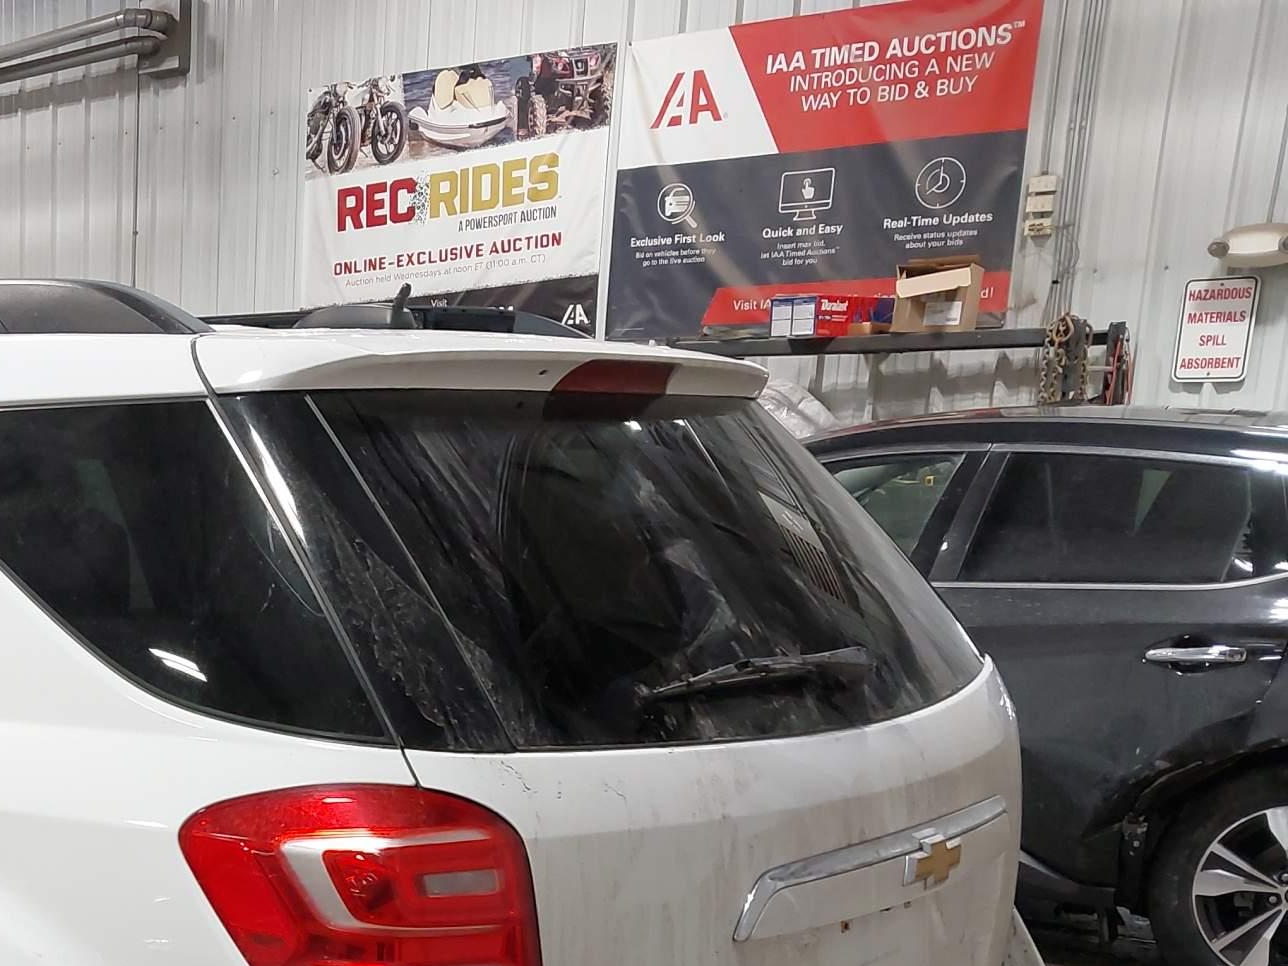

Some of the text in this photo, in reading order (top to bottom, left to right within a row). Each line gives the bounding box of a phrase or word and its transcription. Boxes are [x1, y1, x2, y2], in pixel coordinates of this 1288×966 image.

[766, 52, 806, 74] IAA
[812, 41, 880, 68] TIMED
[790, 51, 995, 91] INTRODUCING A NEW
[801, 75, 978, 111] WAY TO BID & BUY
[337, 152, 560, 233] REC RIDES
[458, 206, 557, 232] A POWERSPORT AUCTION
[883, 212, 993, 229] Real-Time Updates
[762, 223, 843, 239] Quick and Easy
[894, 229, 978, 241] Receive status updates
[631, 231, 725, 247] Exclusive First Look
[905, 238, 963, 249] about your bids
[334, 232, 562, 276] ONLINE-EXCLUSIVE AUCTION
[654, 249, 679, 257] vehicles
[681, 248, 700, 256] before
[771, 250, 785, 258] IAA
[786, 249, 806, 257] Timed
[659, 257, 668, 265] the
[345, 278, 374, 287] Auction
[376, 273, 392, 283] held
[393, 268, 442, 281] Wednesdays
[444, 267, 452, 275] at
[1188, 286, 1253, 301] HAZARDOUS
[431, 298, 448, 308] Visit
[733, 299, 757, 311] Visit
[1187, 310, 1247, 325] MATERIALS
[1199, 334, 1227, 347] SPILL
[1179, 355, 1241, 370] ABSORBENT
